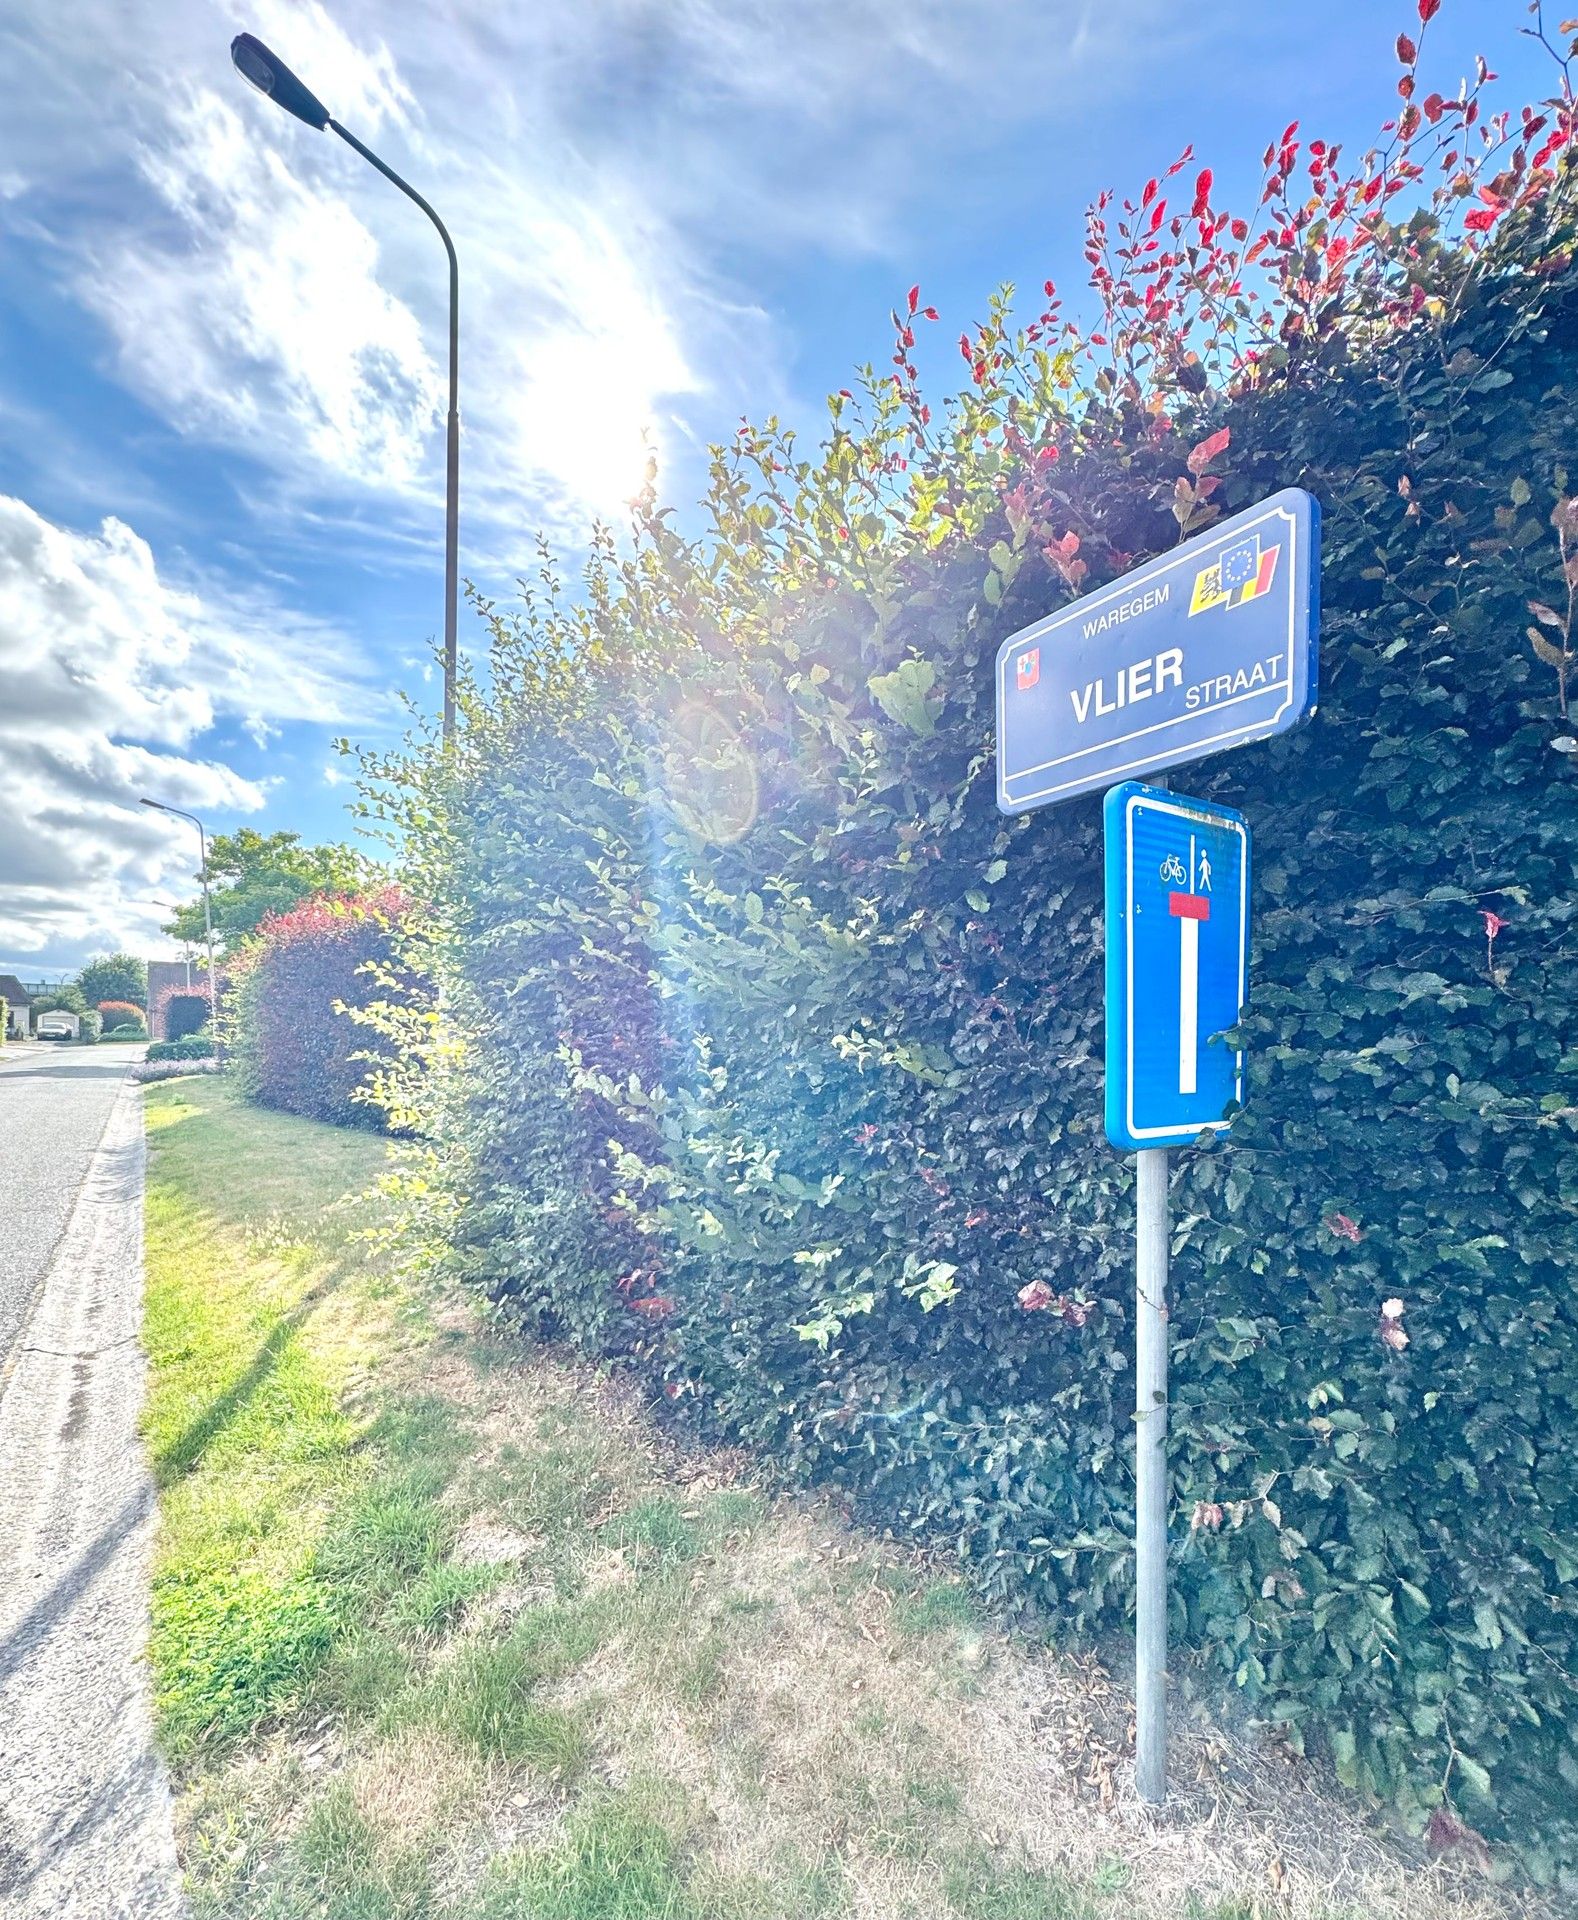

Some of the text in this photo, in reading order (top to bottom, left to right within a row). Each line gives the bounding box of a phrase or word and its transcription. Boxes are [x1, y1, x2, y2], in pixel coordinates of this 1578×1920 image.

[1083, 584, 1169, 639] WAREGEM
[1070, 648, 1283, 724] VLIER STRAAT
